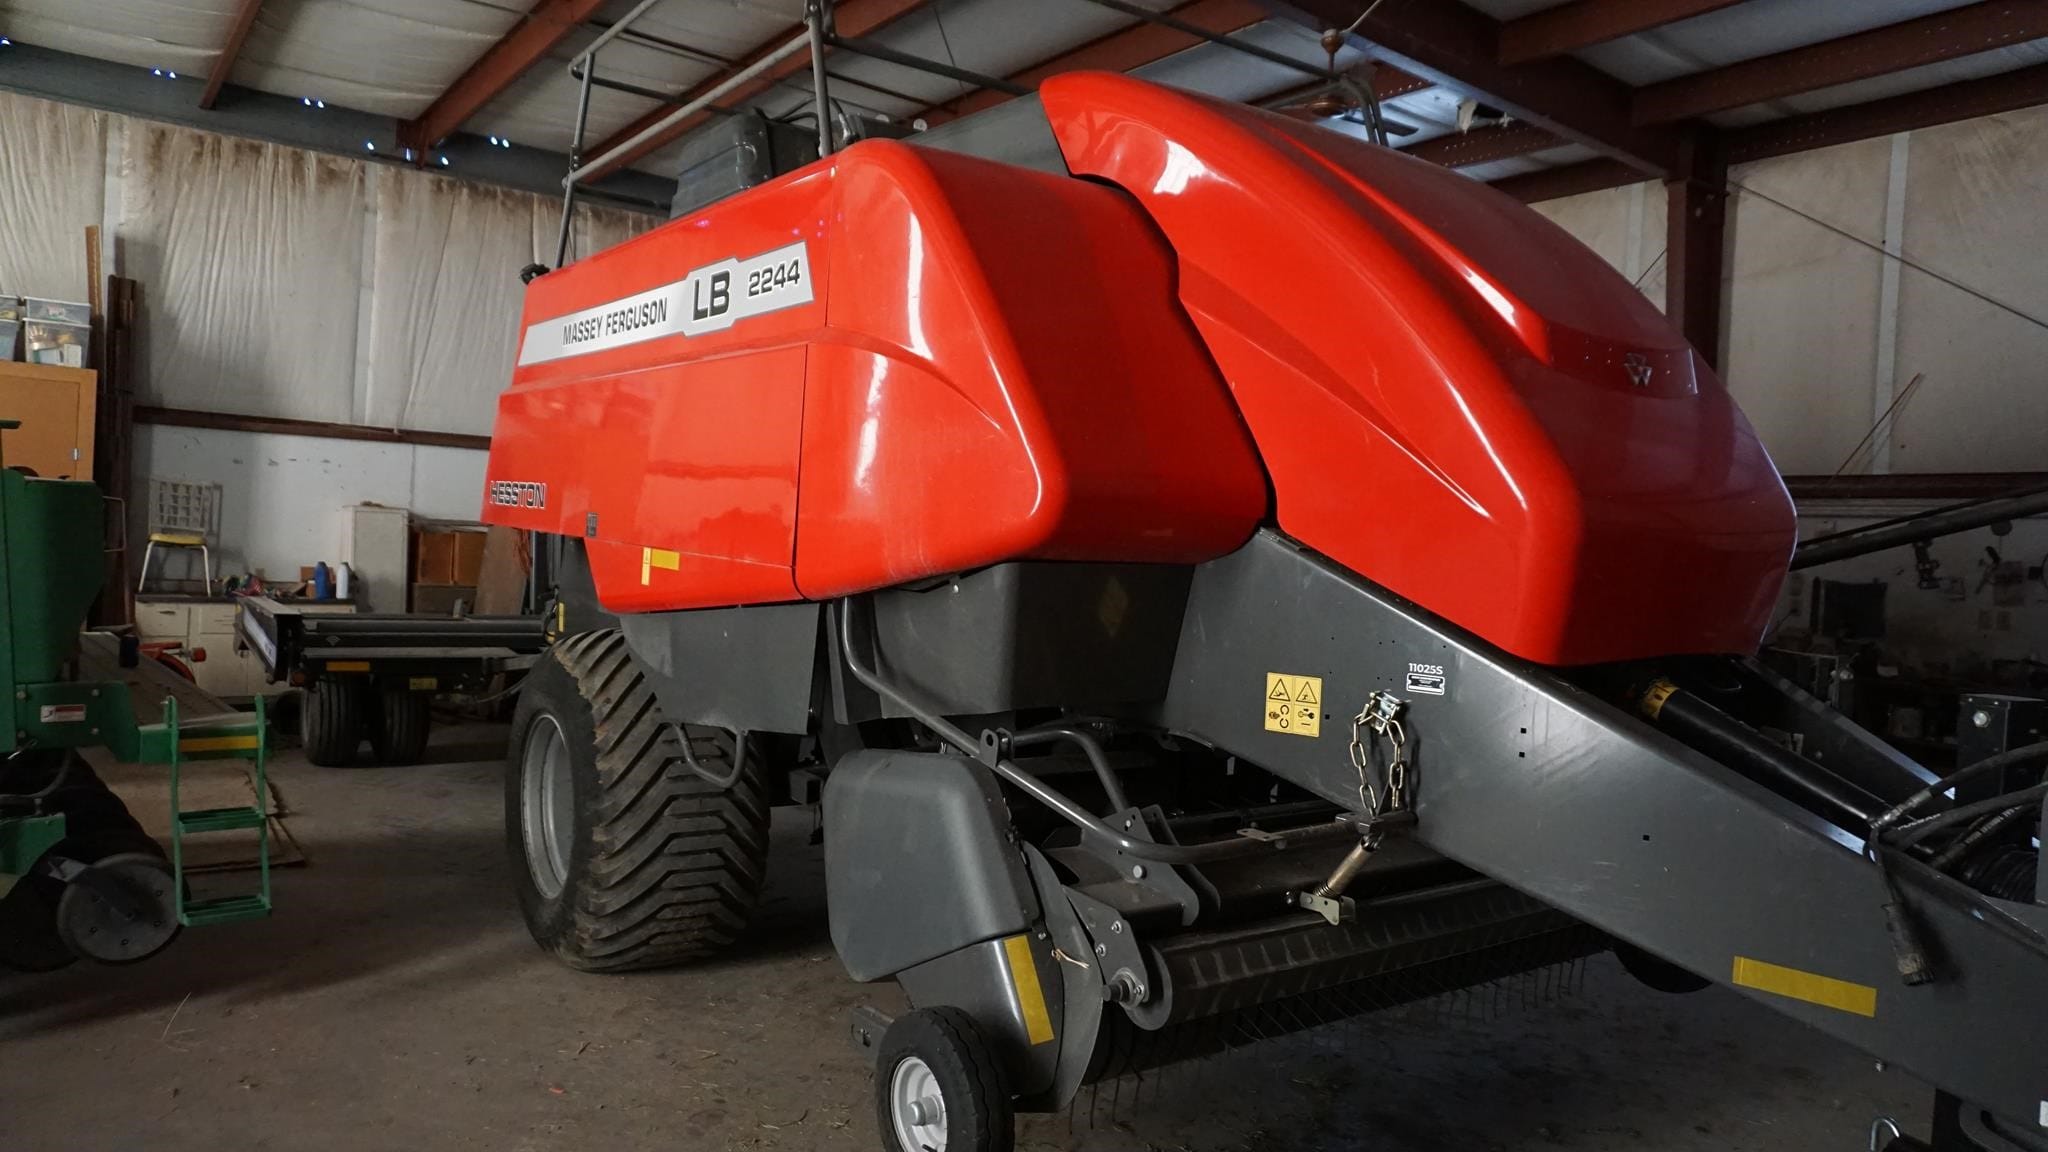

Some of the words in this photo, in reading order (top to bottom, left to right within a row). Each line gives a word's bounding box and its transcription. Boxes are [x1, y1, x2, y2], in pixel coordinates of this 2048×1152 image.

[562, 315, 603, 346] MASSEY
[605, 297, 667, 336] FERGUSON
[693, 270, 730, 321] LB
[748, 259, 801, 297] 2244
[490, 480, 546, 509] HESSTON
[1408, 662, 1443, 675] 11025S
